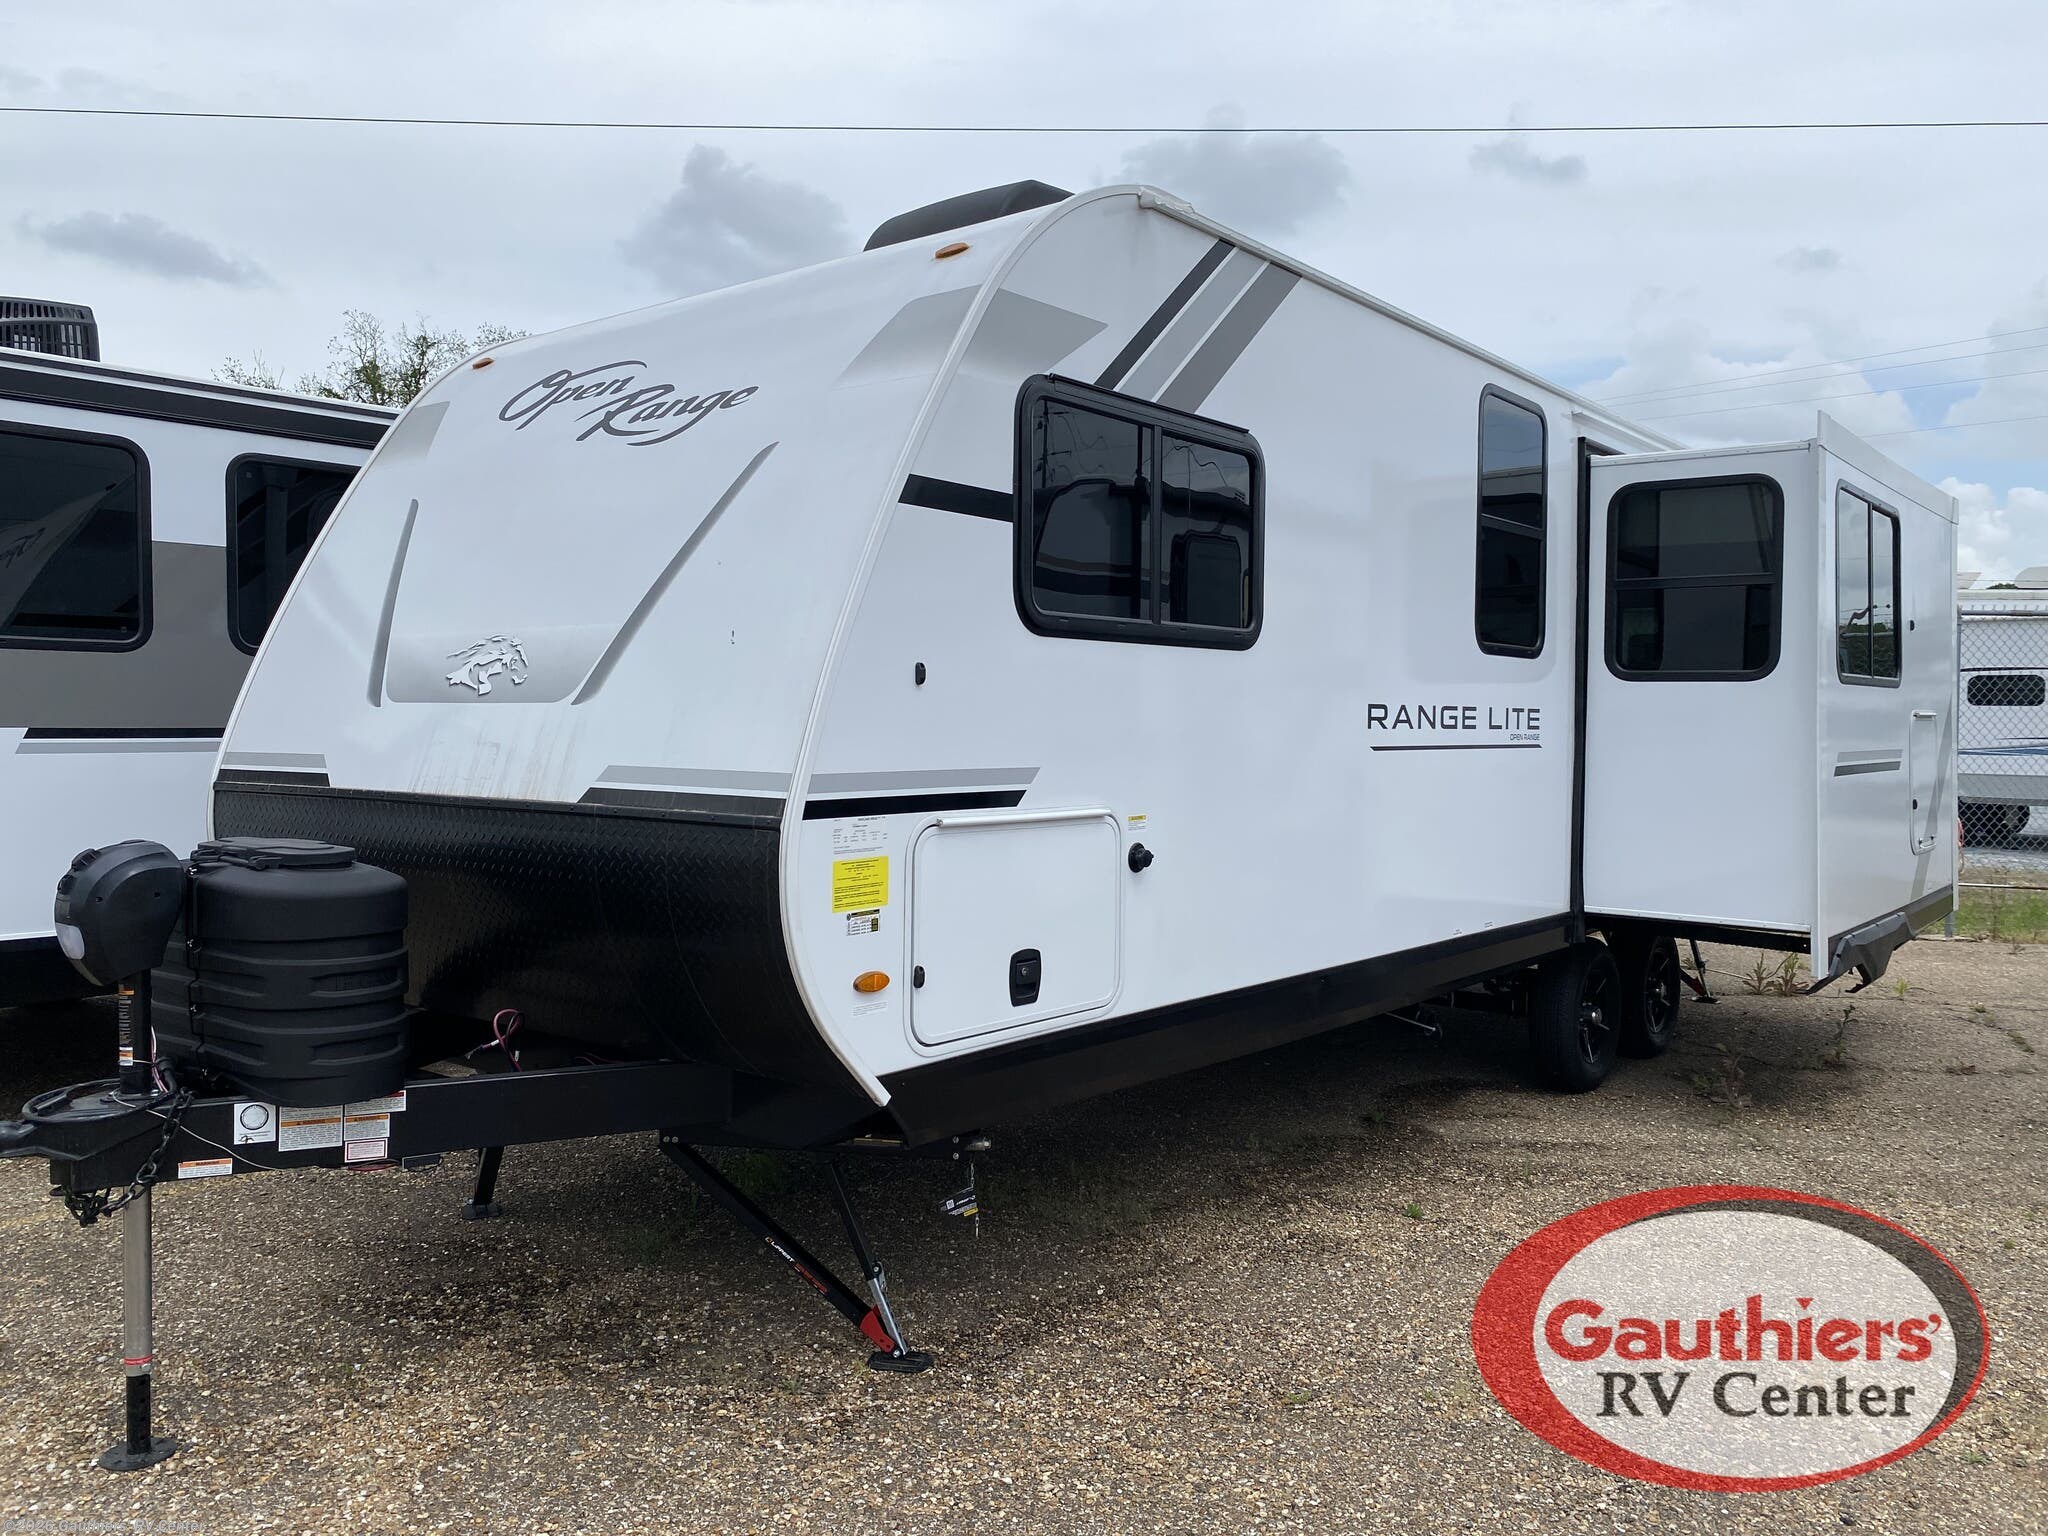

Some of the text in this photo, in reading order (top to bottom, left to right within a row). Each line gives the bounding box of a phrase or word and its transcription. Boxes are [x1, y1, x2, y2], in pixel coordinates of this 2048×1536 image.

[499, 360, 648, 431] Open
[574, 384, 760, 447] Range
[1367, 703, 1540, 730] RANGE LITE
[1509, 733, 1540, 741] OPEN RANGE
